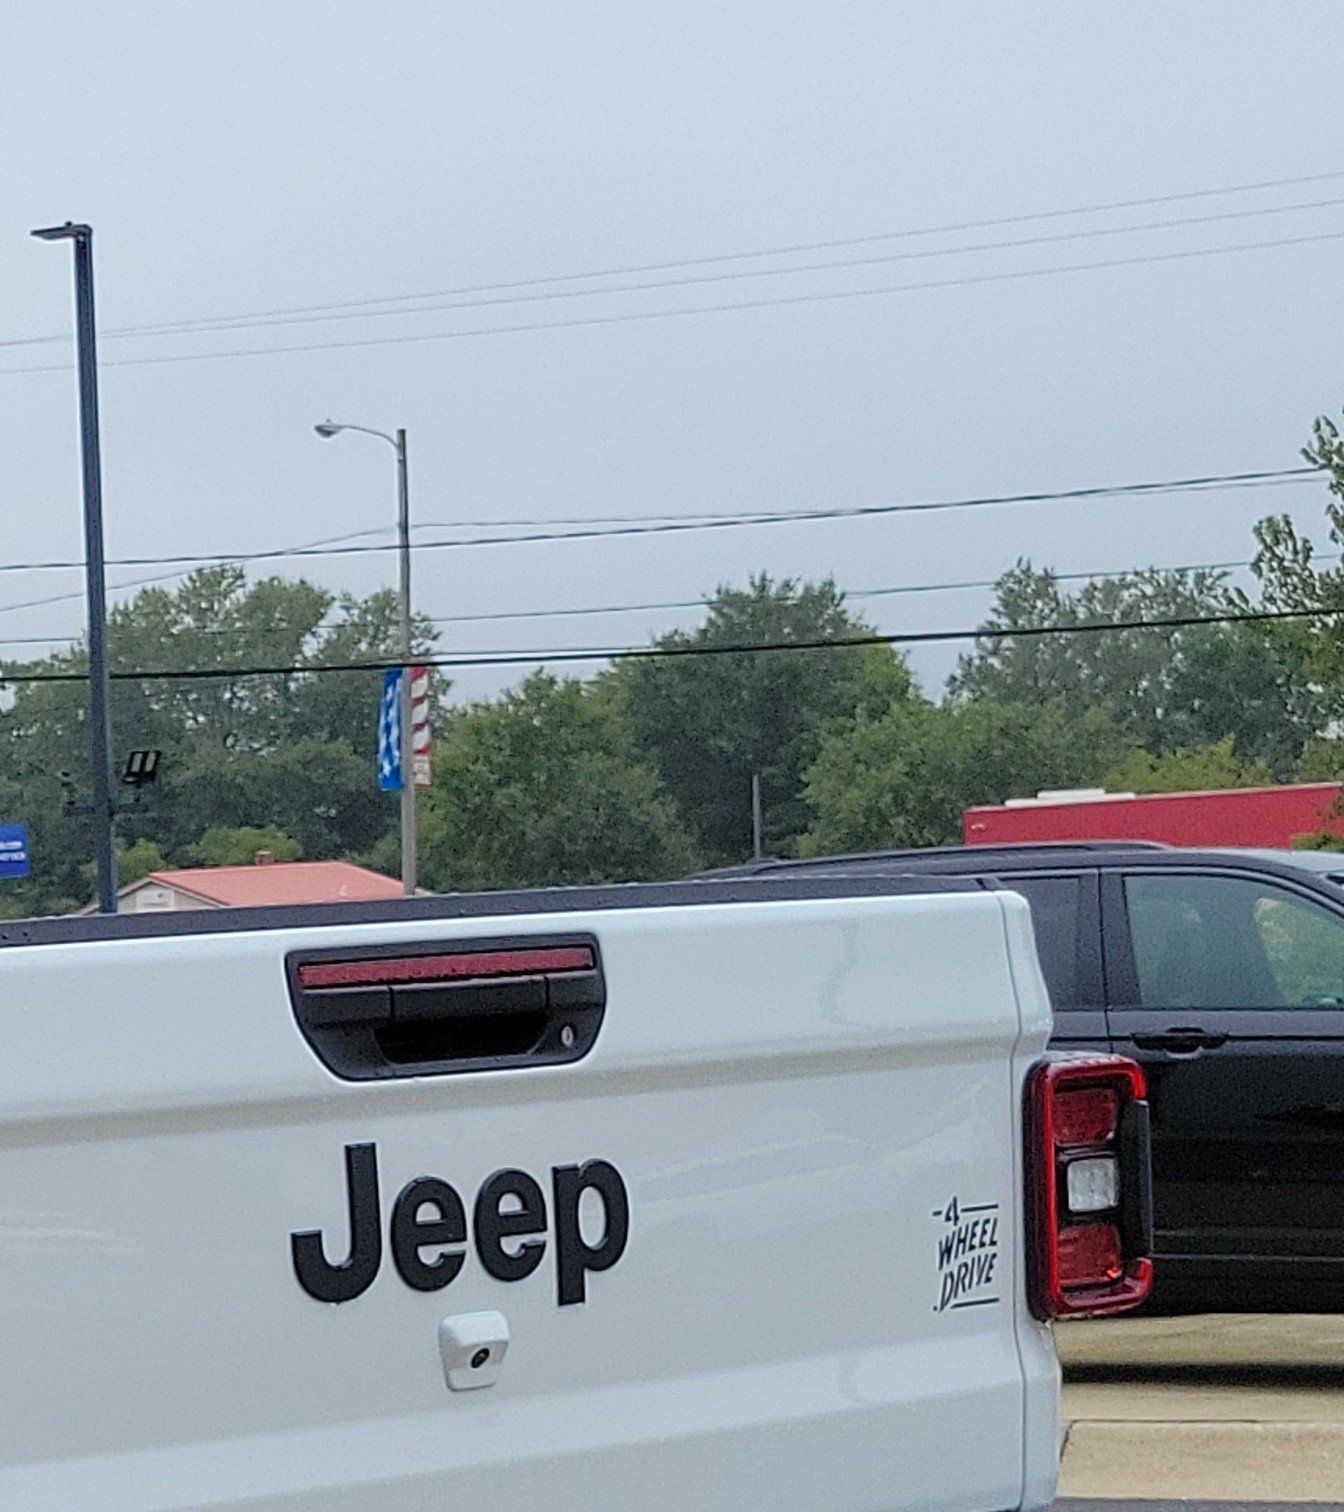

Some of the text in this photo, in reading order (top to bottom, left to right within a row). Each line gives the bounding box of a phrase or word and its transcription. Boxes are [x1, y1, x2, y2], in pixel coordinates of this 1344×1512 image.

[290, 1142, 630, 1306] Jeep
[944, 1196, 960, 1226] 4
[938, 1217, 998, 1271] WHEEL
[939, 1252, 998, 1312] DRIVE
